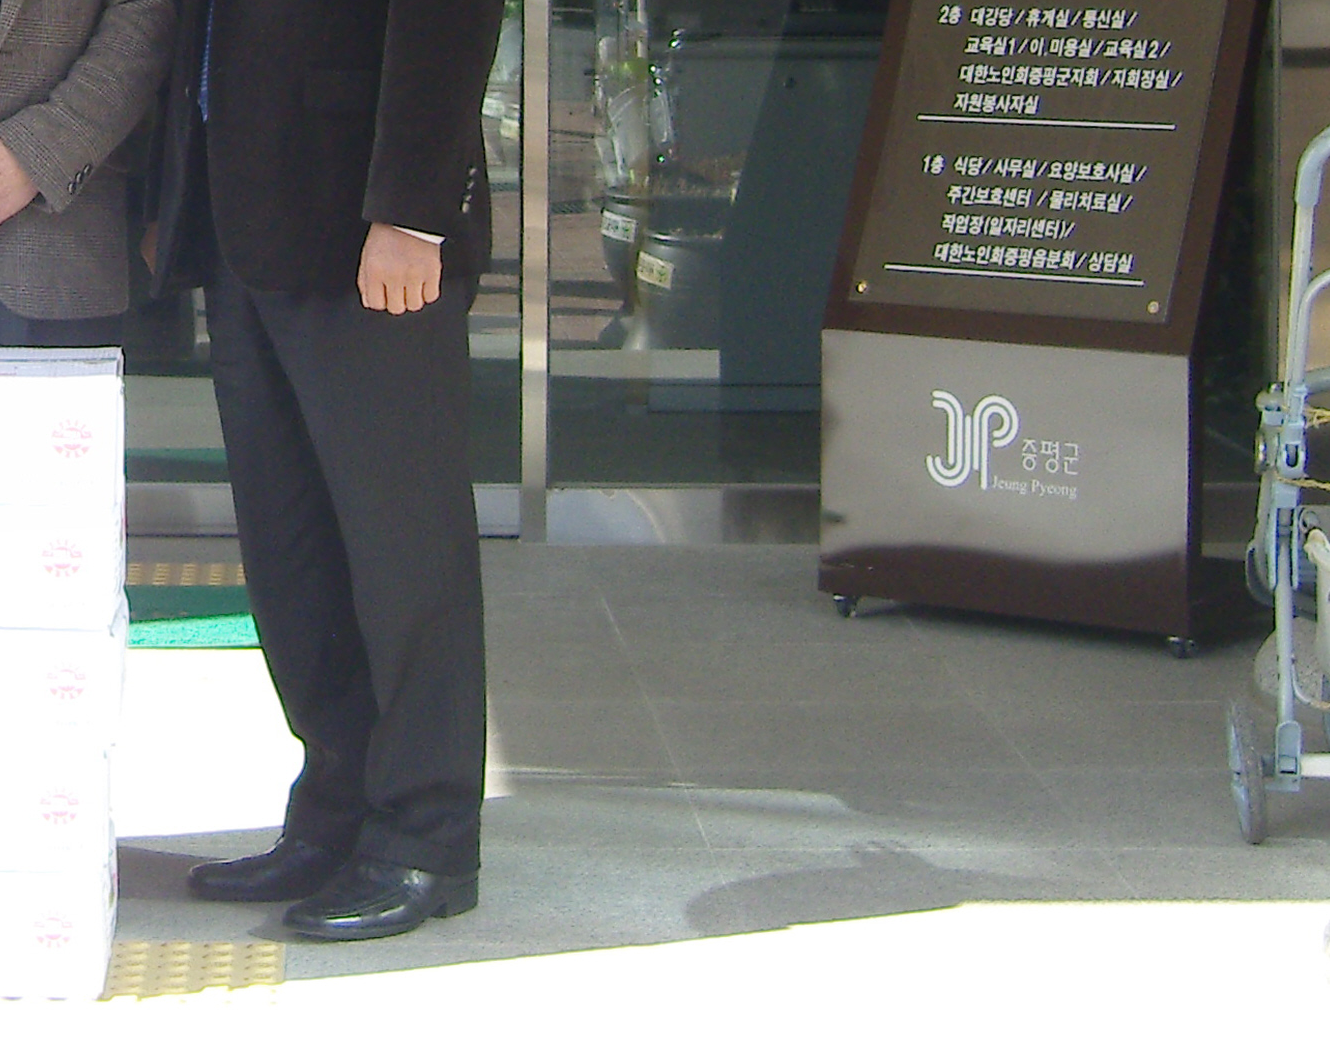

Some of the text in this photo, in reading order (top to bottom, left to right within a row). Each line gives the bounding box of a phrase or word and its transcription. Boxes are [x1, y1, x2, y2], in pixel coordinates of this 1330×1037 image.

[938, 5, 963, 25] 2층
[953, 92, 1040, 115] 자원봉사자실
[922, 154, 945, 175] 1층
[1021, 438, 1080, 476] 증평군
[992, 475, 1078, 500] Jeung Pyeong
